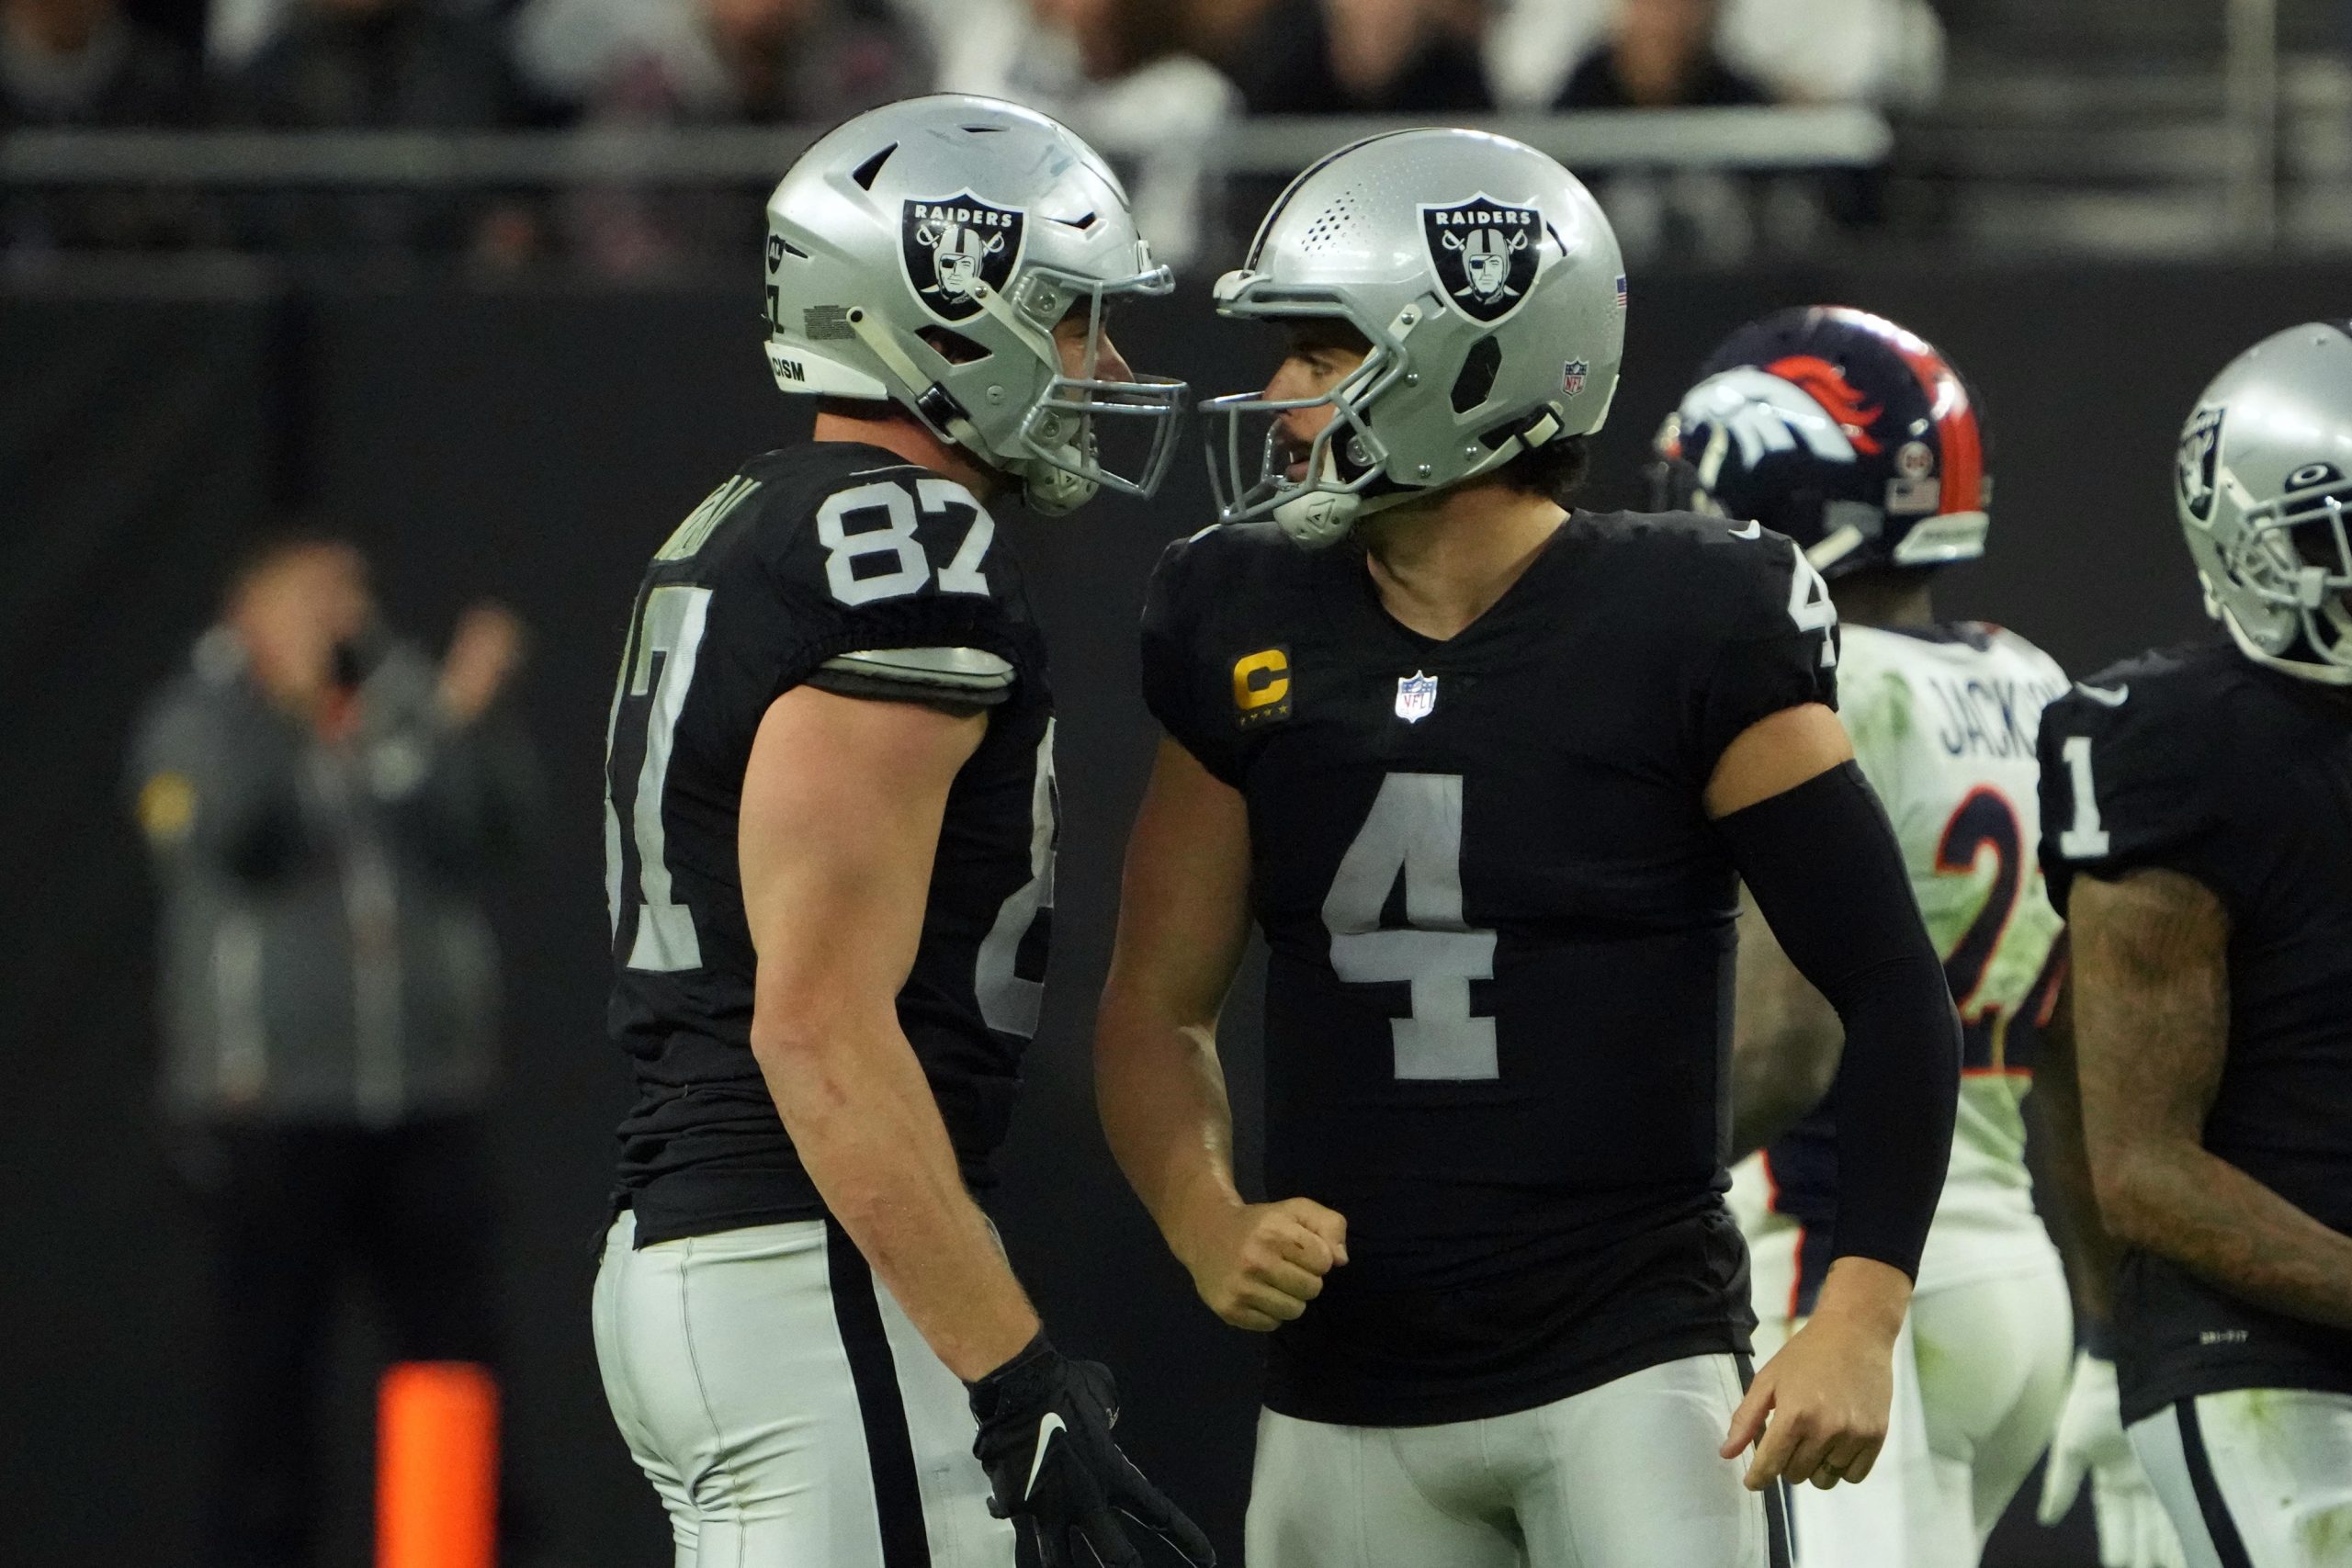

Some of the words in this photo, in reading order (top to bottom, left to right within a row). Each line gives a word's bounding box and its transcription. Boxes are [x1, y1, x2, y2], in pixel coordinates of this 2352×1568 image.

[914, 204, 1012, 228] RAIDERS
[1435, 210, 1532, 225] RAIDERS
[816, 479, 995, 606] 87
[1788, 543, 1838, 668] 4
[1233, 649, 1289, 710] C
[1403, 693, 1427, 710] NFL
[1928, 674, 2067, 757] JACK
[605, 586, 713, 972] 7
[2062, 737, 2109, 858] 1
[1321, 773, 1499, 1080] 4
[1933, 783, 2067, 1078] 2
